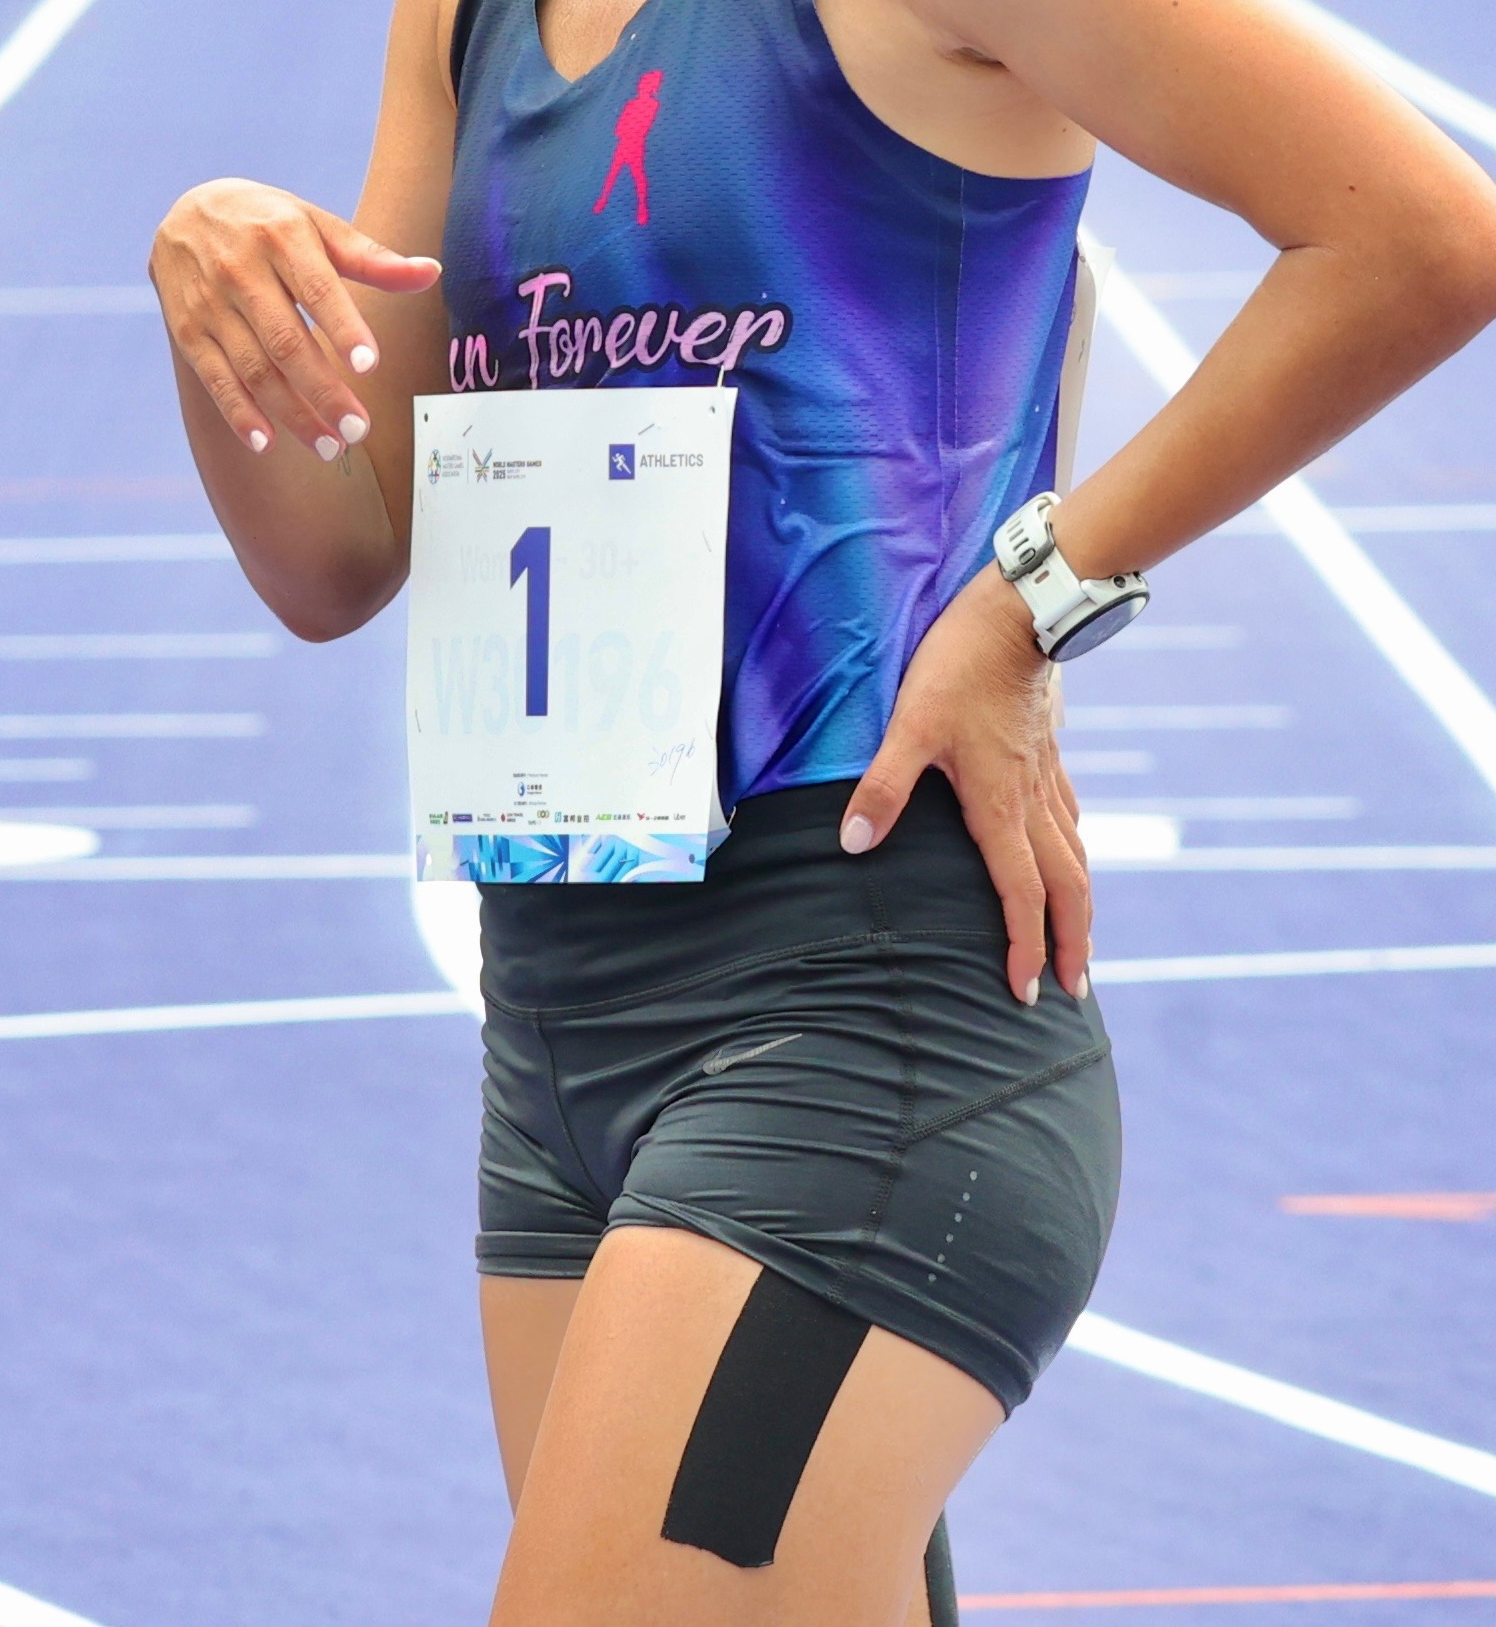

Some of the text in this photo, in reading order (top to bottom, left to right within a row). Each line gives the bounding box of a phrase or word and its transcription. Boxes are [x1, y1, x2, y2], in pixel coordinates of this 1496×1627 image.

[448, 271, 786, 393] un Forever
[640, 453, 704, 468] ATHLETICS
[509, 525, 552, 717] 1
